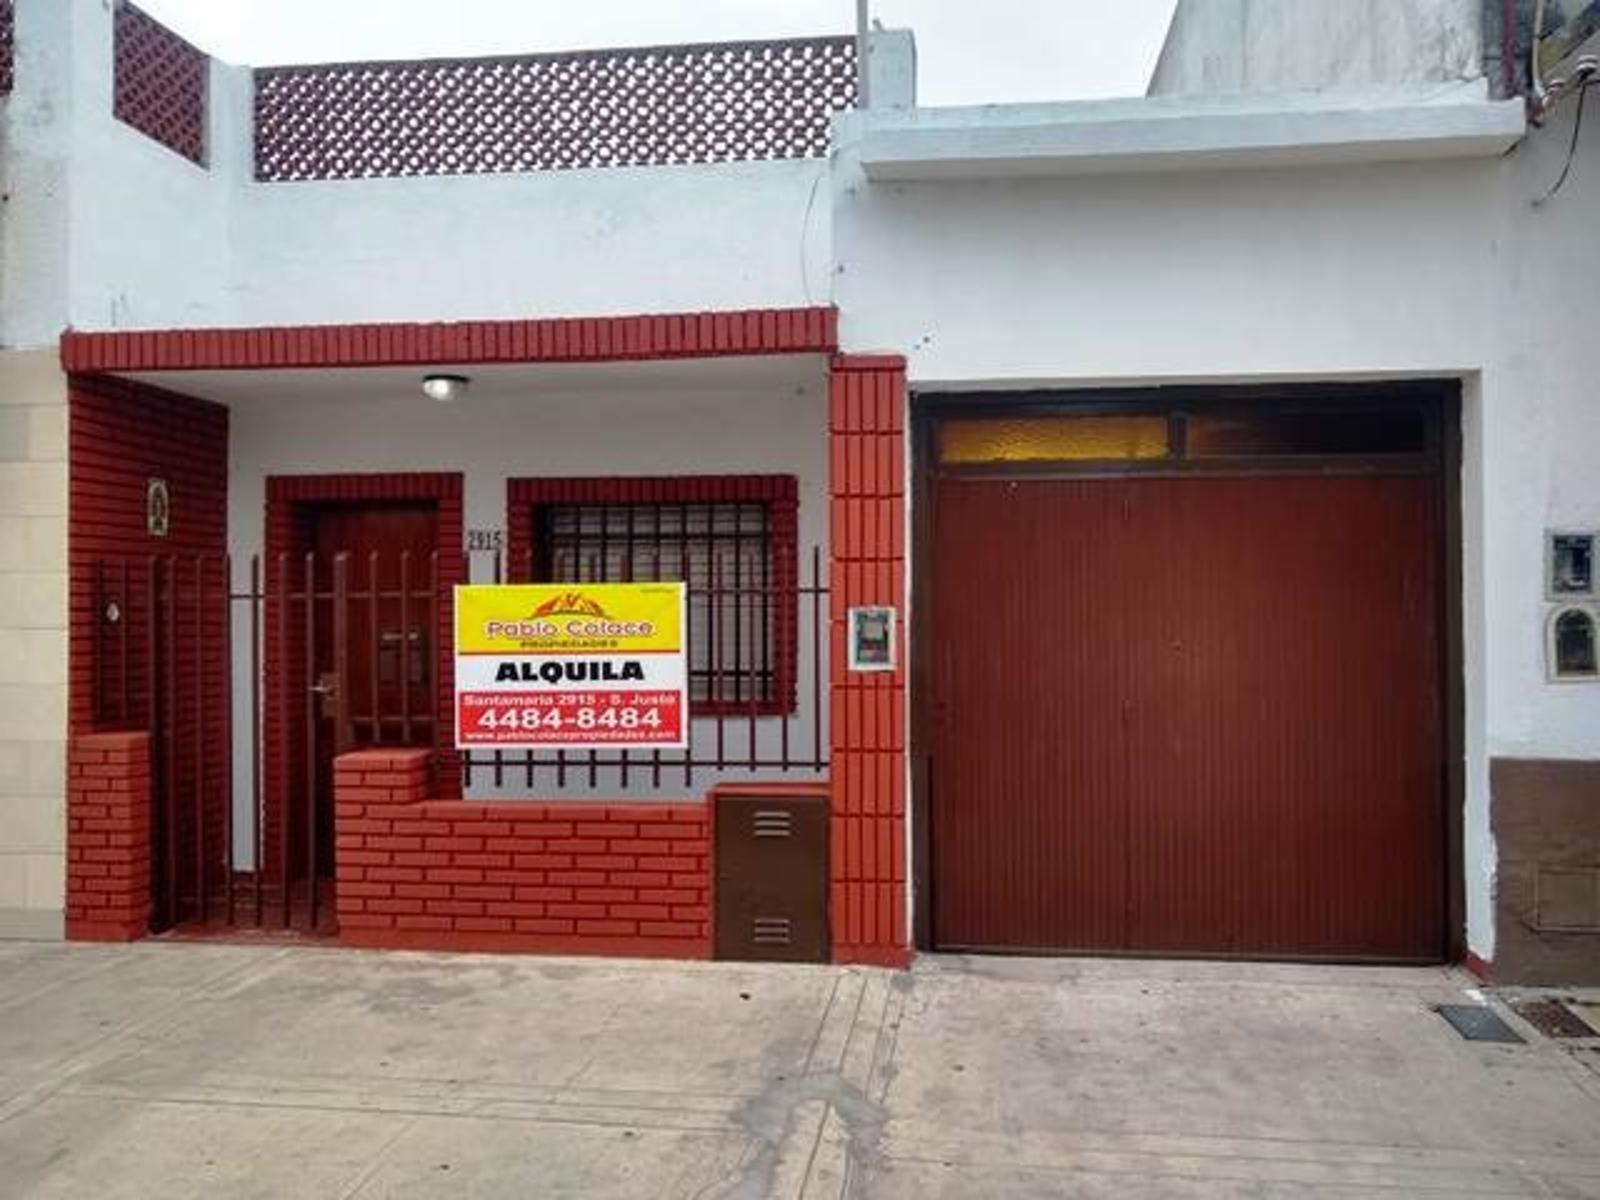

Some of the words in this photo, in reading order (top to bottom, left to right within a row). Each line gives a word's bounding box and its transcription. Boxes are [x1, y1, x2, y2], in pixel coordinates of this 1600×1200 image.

[469, 530, 502, 551] 2915
[486, 621, 558, 639] Pablo
[495, 661, 645, 683] ALQUILA
[558, 693, 596, 706] 2915
[478, 707, 662, 729] 4484-8484
